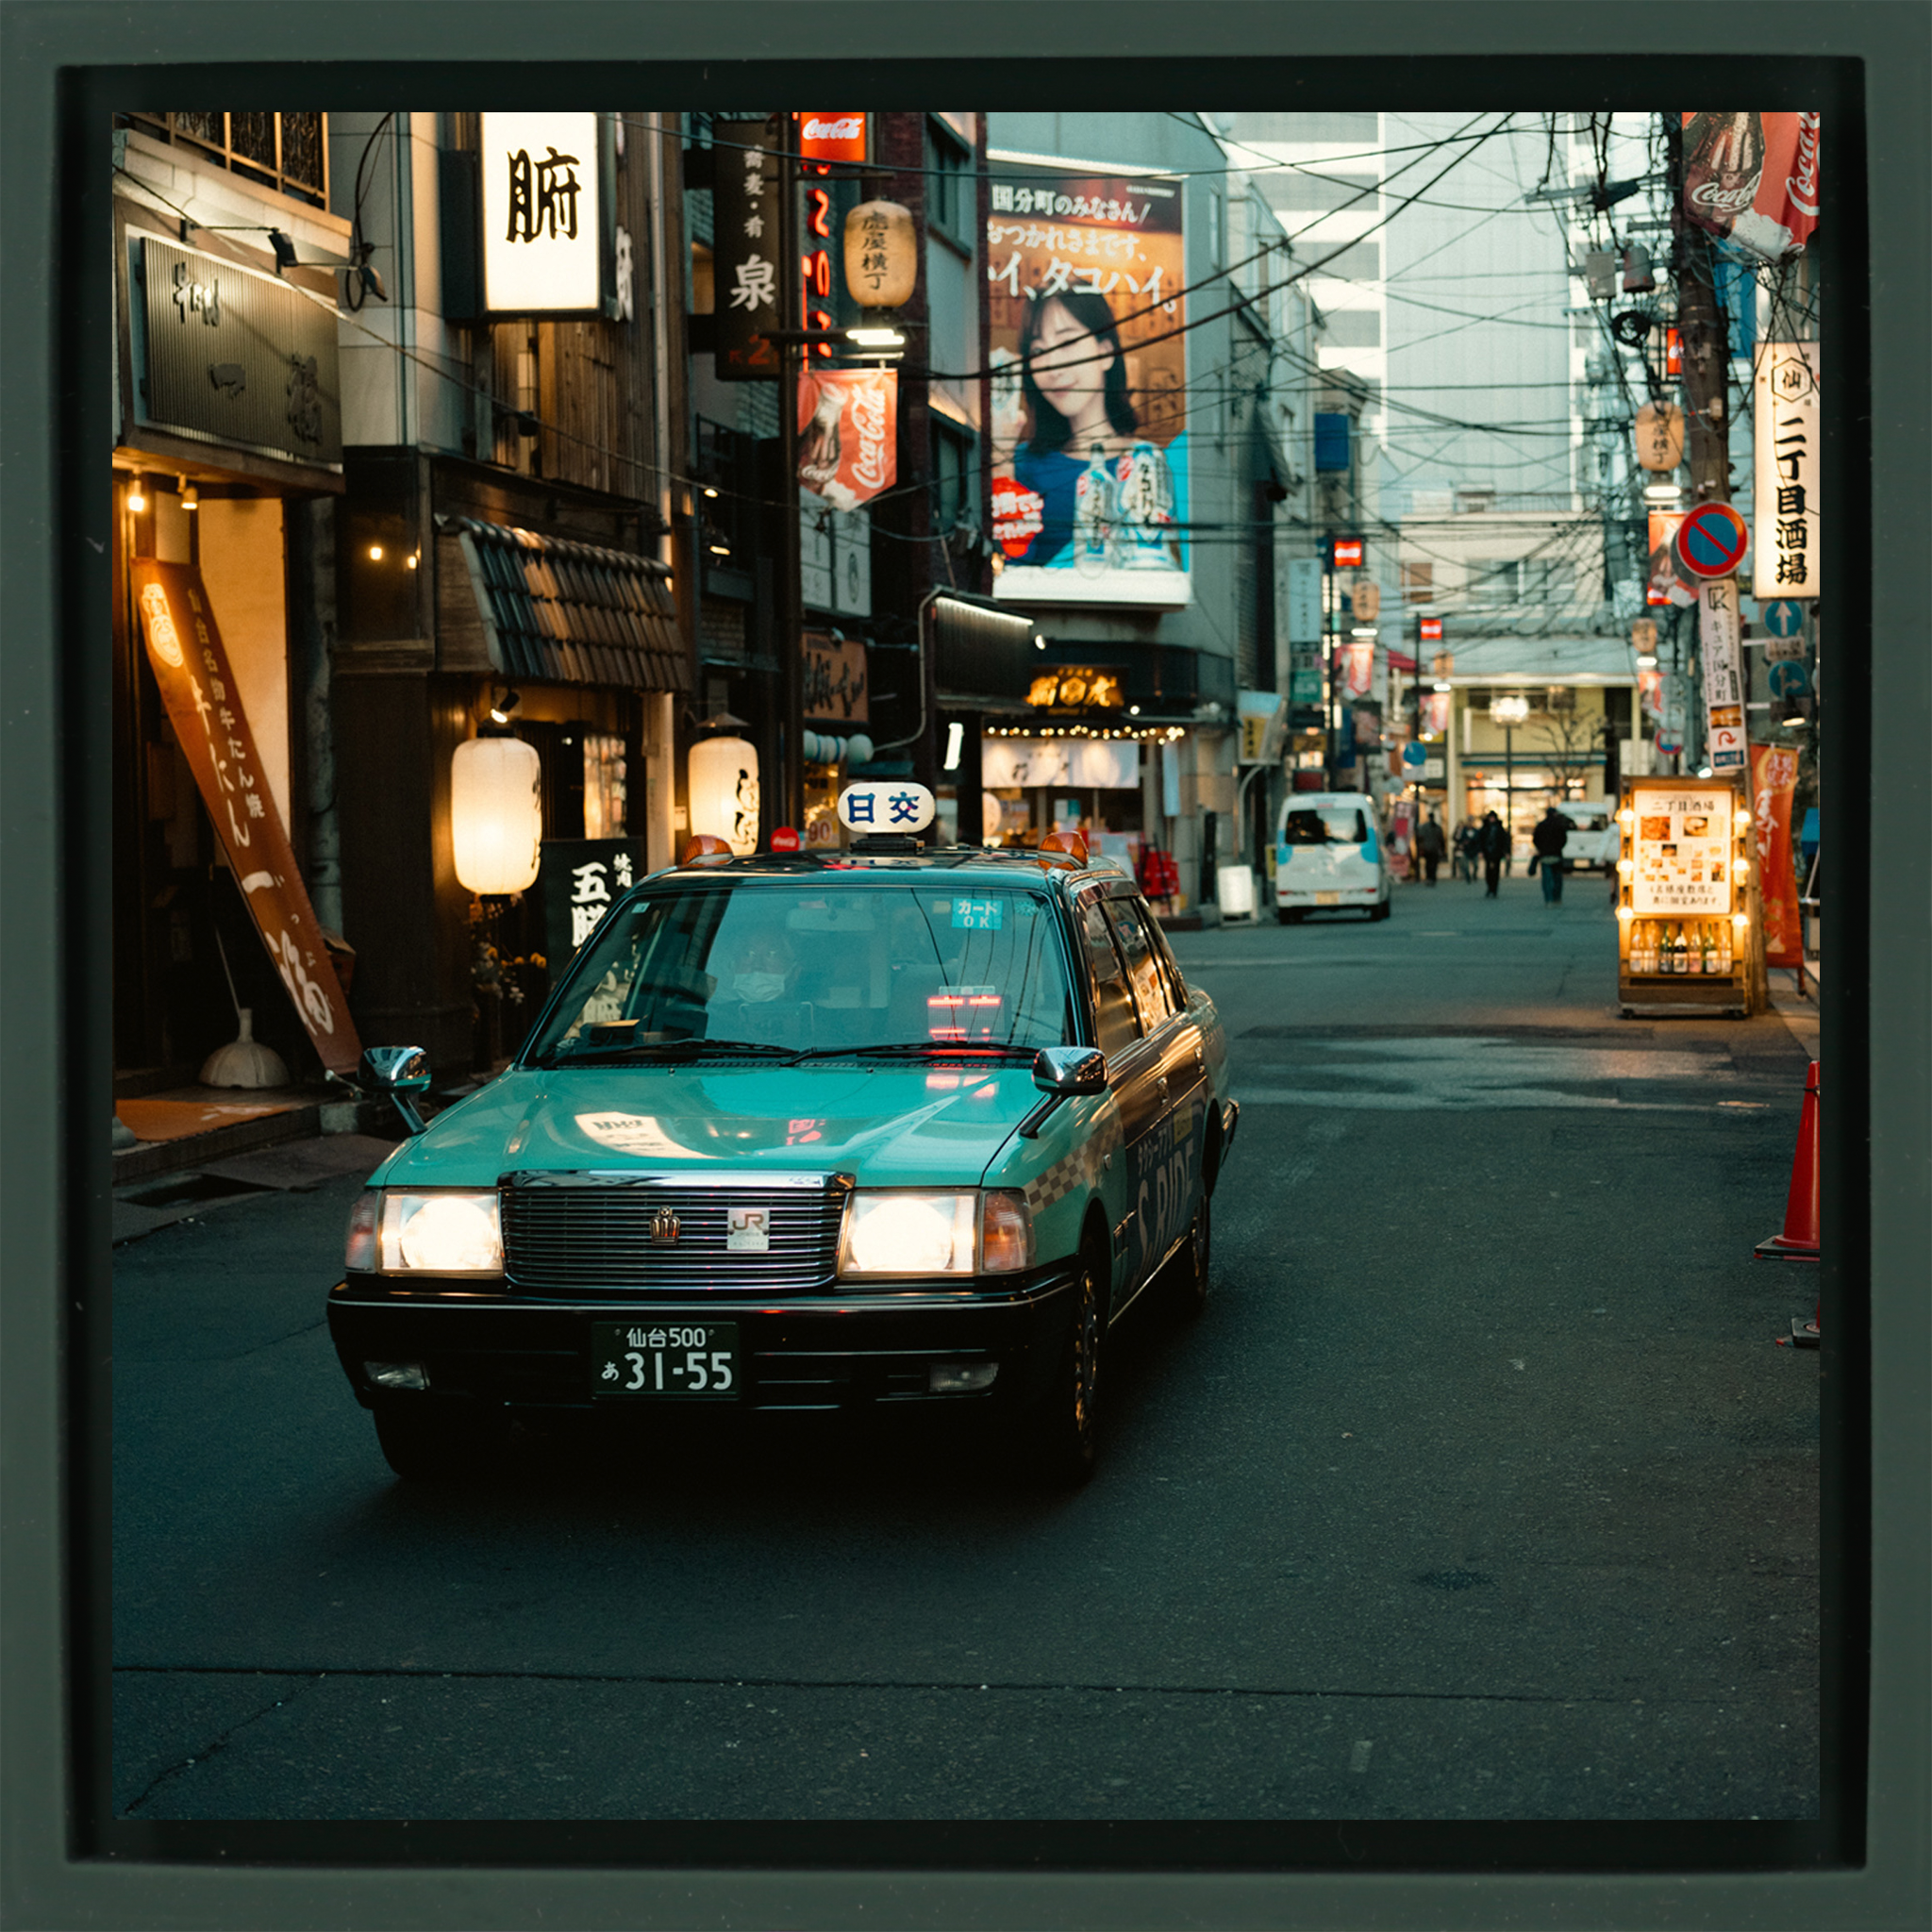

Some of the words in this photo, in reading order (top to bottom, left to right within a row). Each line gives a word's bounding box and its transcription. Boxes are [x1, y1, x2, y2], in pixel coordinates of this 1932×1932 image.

[802, 118, 864, 140] Coca-Cola
[729, 253, 775, 311] 泉
[851, 383, 886, 489] Coca-Cola
[1774, 416, 1808, 586] 二丁目酒場
[847, 791, 921, 824] 日交
[958, 899, 998, 916] カード
[732, 1213, 765, 1231] JR
[601, 1360, 620, 1381] あ
[625, 1352, 732, 1391] 31-55
